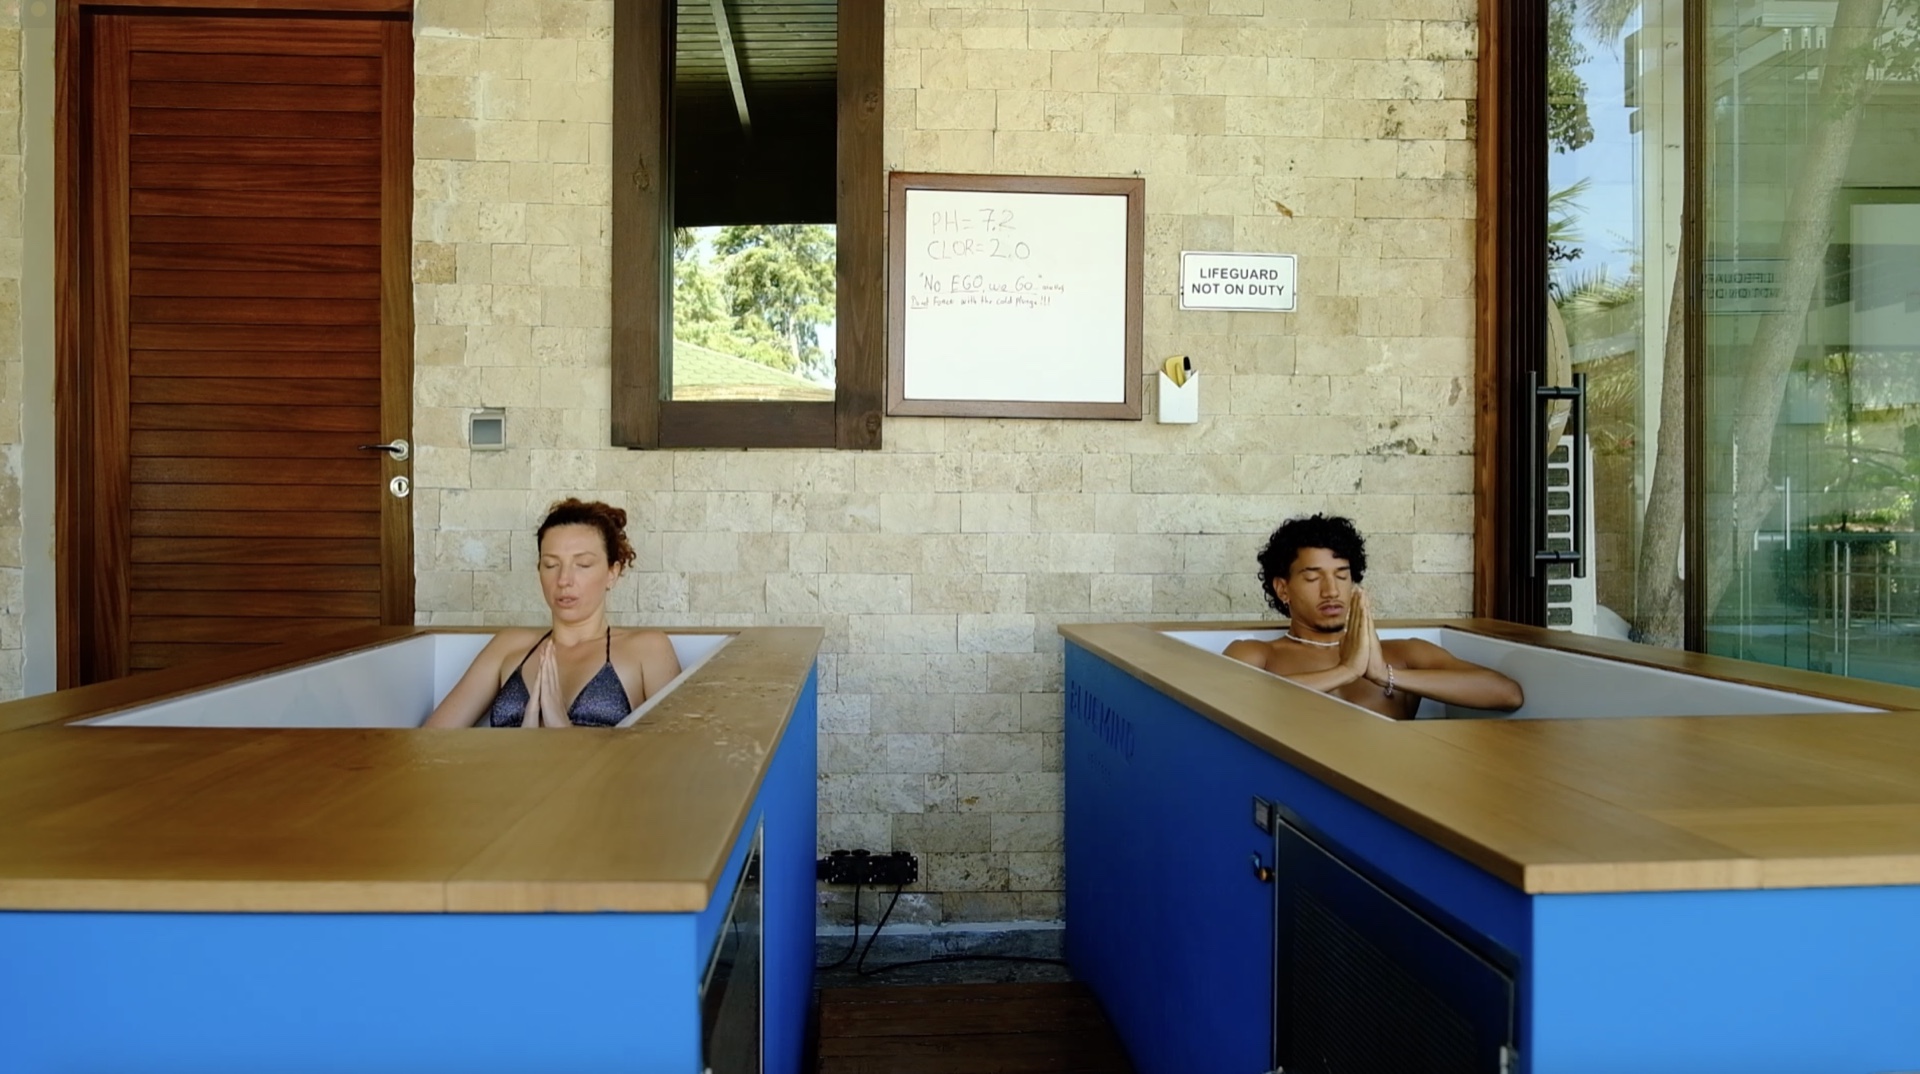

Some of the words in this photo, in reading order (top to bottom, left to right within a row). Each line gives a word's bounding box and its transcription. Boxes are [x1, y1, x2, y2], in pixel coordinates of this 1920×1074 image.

[979, 208, 1017, 232] 7.2
[989, 238, 1031, 260] 2.0
[1199, 267, 1279, 281] LIFEGUARD
[988, 282, 1008, 292] we
[1191, 283, 1220, 295] NOT
[1224, 283, 1244, 295] ON
[1248, 284, 1285, 296] DUTY
